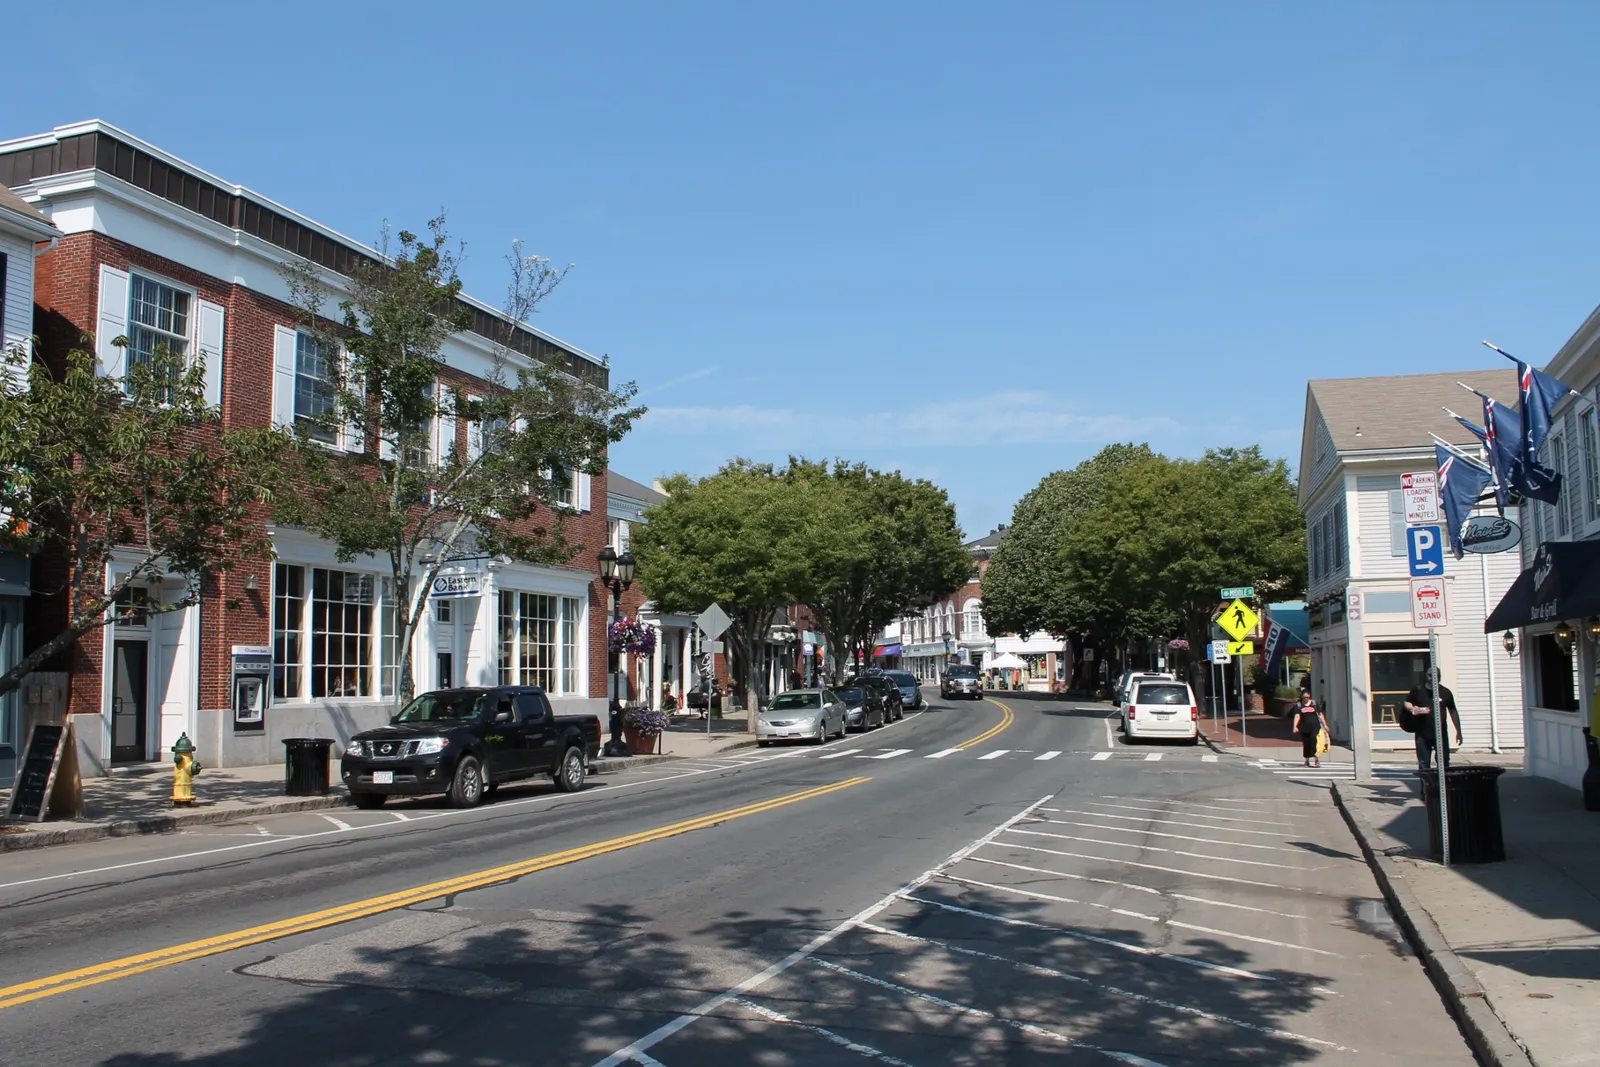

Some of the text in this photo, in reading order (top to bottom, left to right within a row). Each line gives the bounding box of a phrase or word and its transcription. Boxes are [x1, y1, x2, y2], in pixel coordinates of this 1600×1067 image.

[1402, 476, 1412, 487] NO
[1406, 488, 1433, 496] LOADING
[1408, 510, 1435, 519] MINUTES
[1460, 519, 1510, 540] Main St
[1413, 530, 1434, 560] P
[448, 576, 477, 584] Eastern
[1350, 595, 1359, 605] P
[1421, 601, 1437, 609] TAXI
[1531, 605, 1539, 620] Bar
[1545, 598, 1557, 620] Grill
[1419, 612, 1441, 620] STAND
